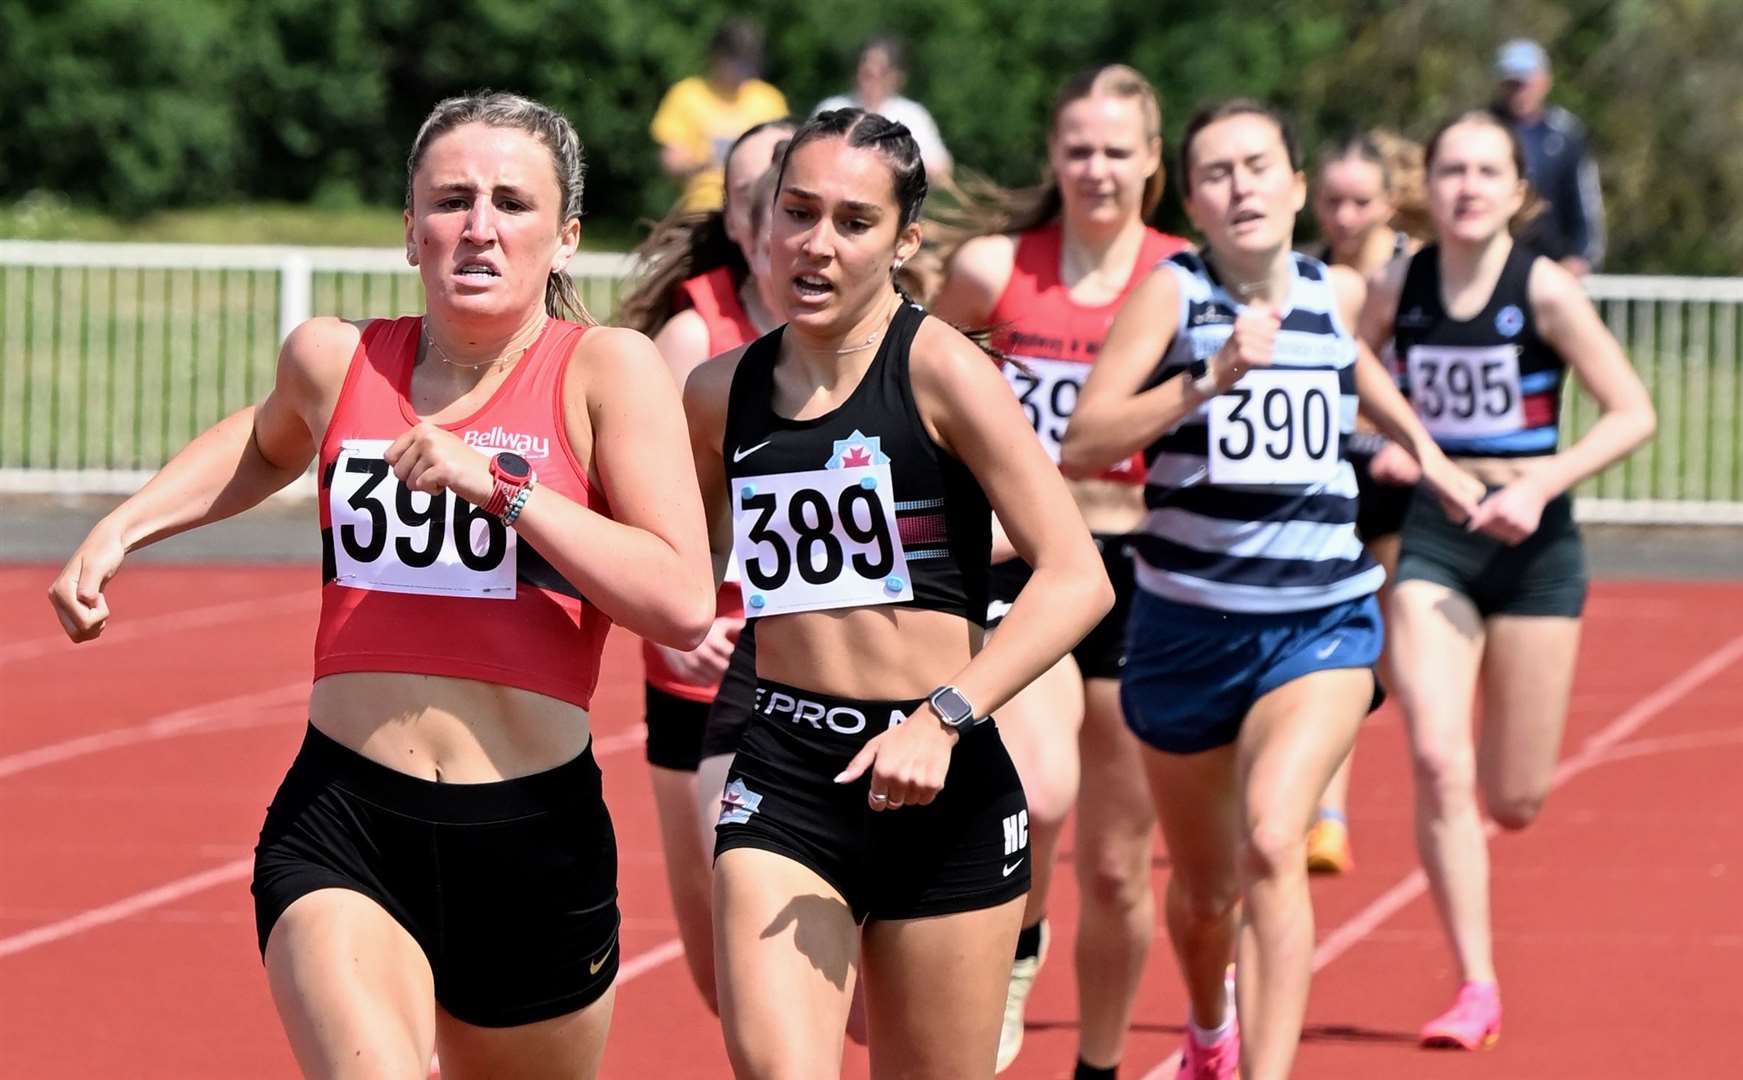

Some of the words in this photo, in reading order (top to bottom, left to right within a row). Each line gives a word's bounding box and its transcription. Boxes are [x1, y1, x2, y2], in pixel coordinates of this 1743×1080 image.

[1219, 388, 1330, 461] 390
[1419, 360, 1513, 420] 395
[463, 426, 549, 459] Bellway
[340, 457, 507, 572] 396
[741, 484, 895, 591] 389
